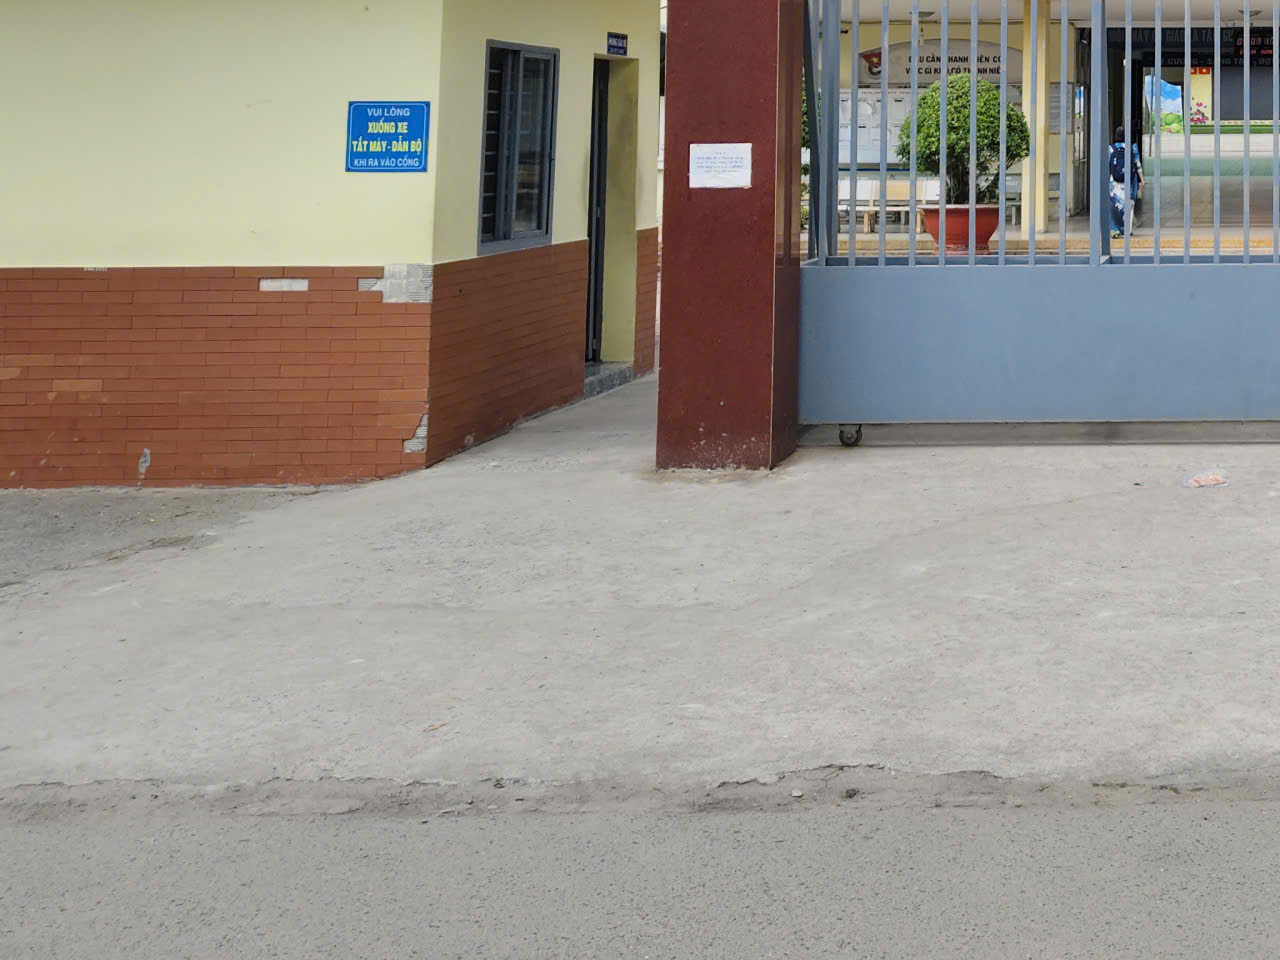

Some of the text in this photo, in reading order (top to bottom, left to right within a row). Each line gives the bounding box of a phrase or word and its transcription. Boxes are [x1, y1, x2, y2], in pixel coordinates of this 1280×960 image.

[946, 55, 968, 63] HANH
[989, 65, 1001, 74] NIÊ
[367, 106, 411, 117] VUI LÒNG
[368, 117, 408, 134] XUỐNG XE
[352, 136, 368, 152] TẮT
[411, 138, 422, 155] BỘ
[354, 154, 419, 167] KHI RA VÀO CỔNG
